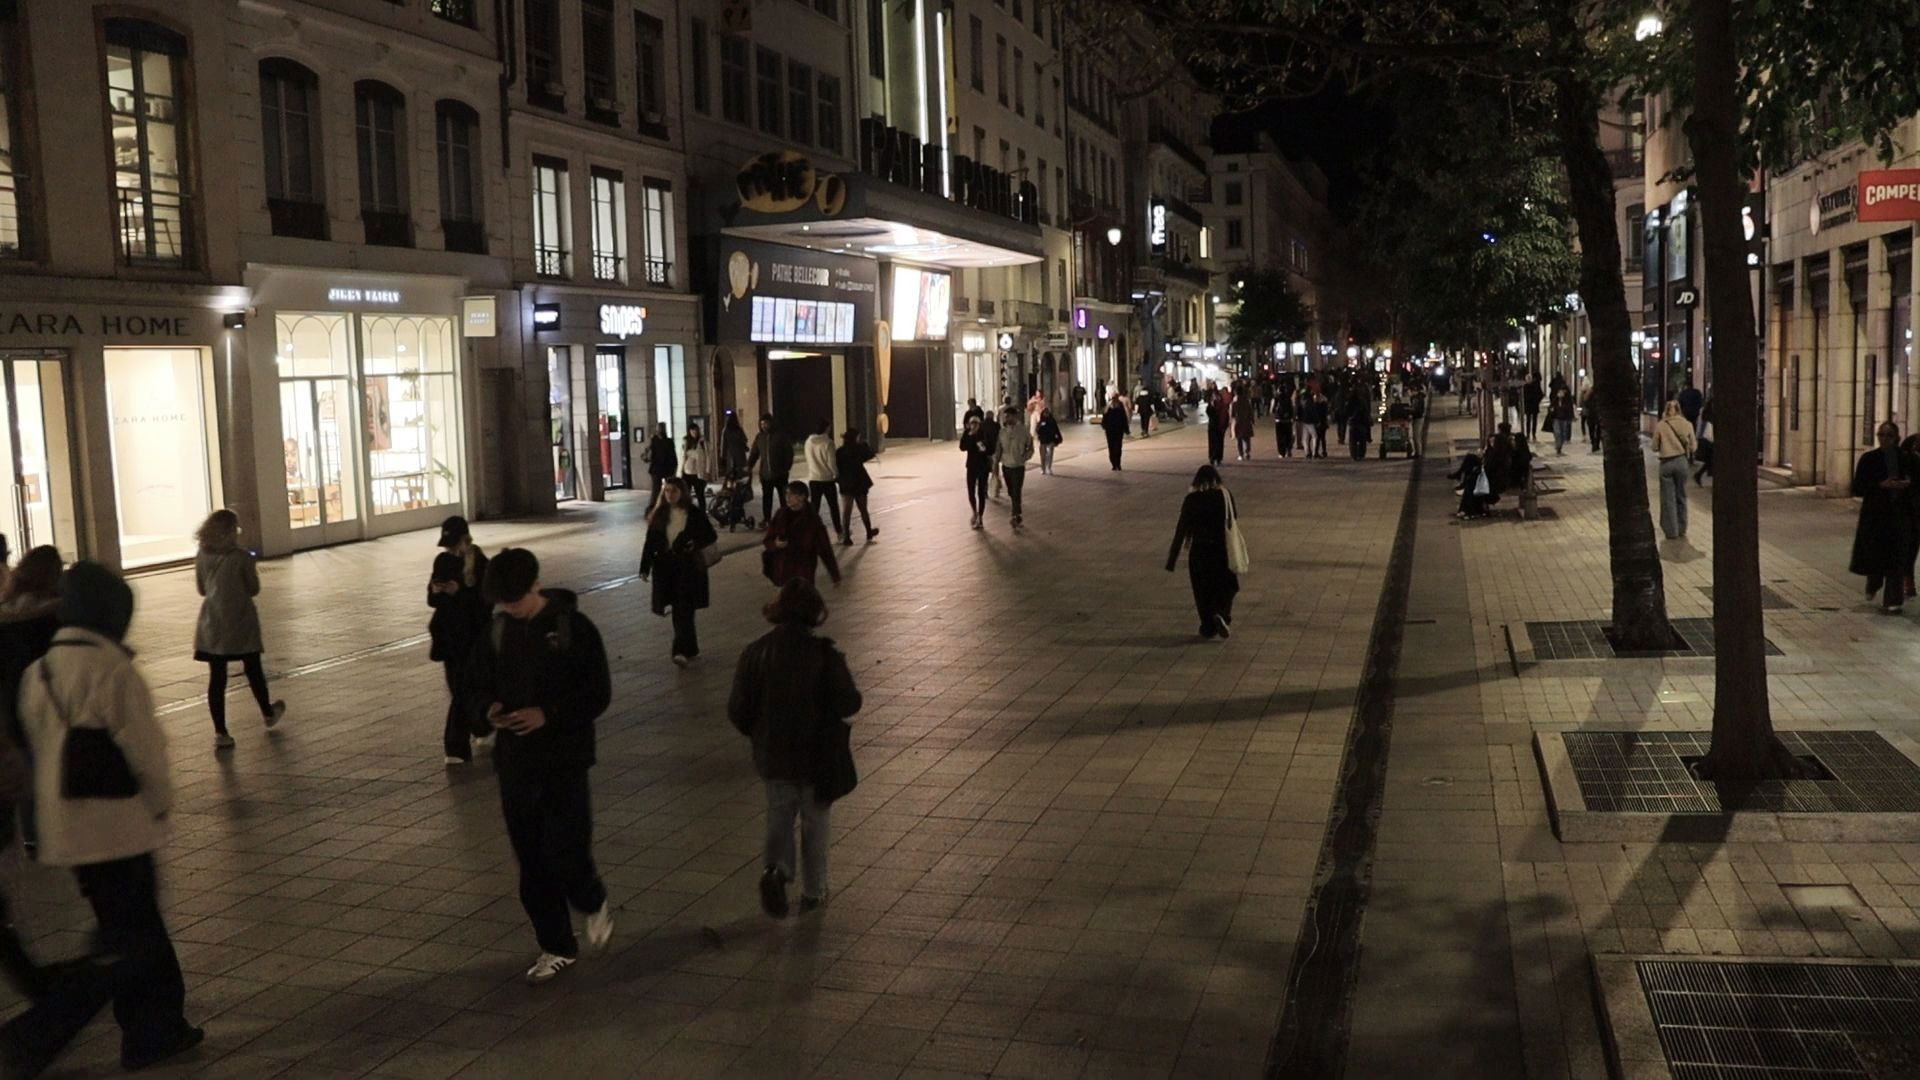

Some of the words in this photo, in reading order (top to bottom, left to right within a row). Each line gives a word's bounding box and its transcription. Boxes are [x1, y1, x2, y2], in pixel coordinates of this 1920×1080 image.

[1152, 205, 1165, 245] fnac
[1676, 292, 1695, 305] JD
[0, 312, 83, 335] ARA
[102, 314, 190, 337] HOME
[153, 413, 187, 424] HOME
